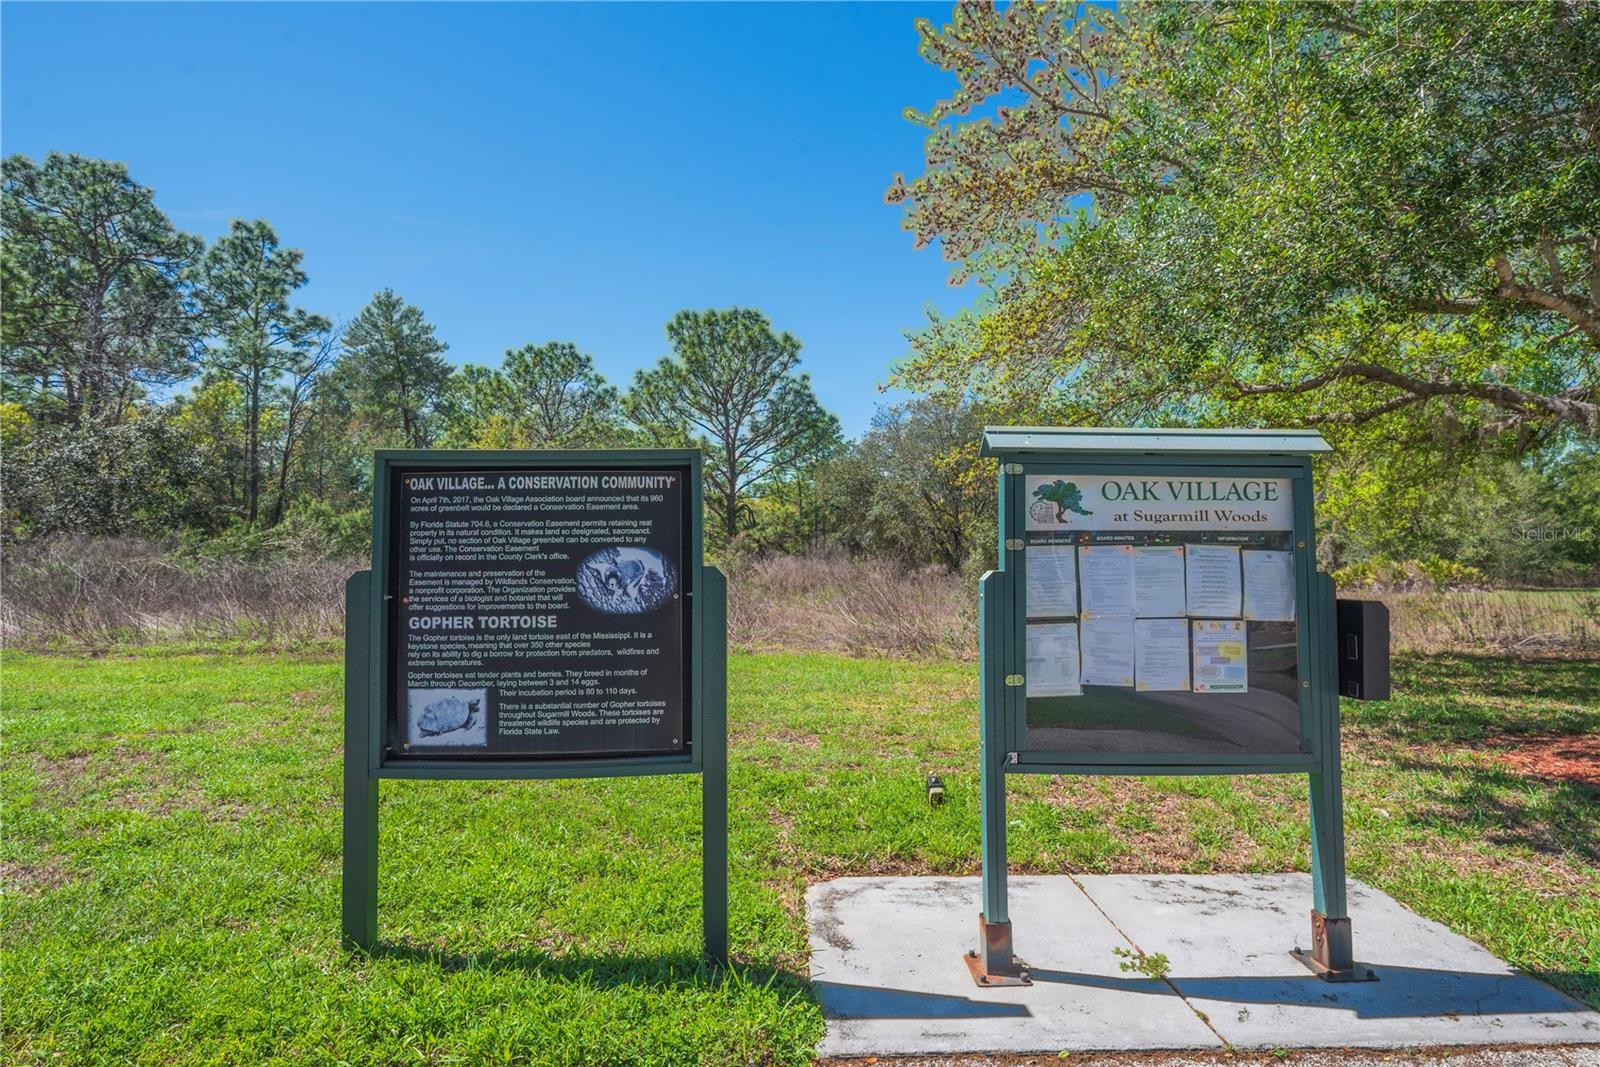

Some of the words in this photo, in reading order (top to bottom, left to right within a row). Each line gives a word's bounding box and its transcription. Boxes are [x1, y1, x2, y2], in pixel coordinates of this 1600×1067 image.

[410, 478, 433, 490] OAK
[438, 477, 494, 490] VILLAGE...
[497, 477, 505, 490] A
[509, 477, 598, 490] CONSERVATION
[602, 476, 672, 489] COMMUNITY
[1101, 480, 1160, 501] OAK
[1166, 481, 1279, 501] VILLAGE
[422, 496, 437, 505] April
[501, 496, 524, 504] Village
[438, 504, 470, 513] greenbelt
[1114, 512, 1129, 522] at
[1133, 510, 1209, 524] Sugarmill
[1215, 510, 1268, 522] Woods
[410, 521, 419, 529] By
[581, 520, 607, 528] permits
[608, 519, 638, 528] retaining
[410, 529, 437, 537] property
[415, 586, 444, 595] nonprofit
[502, 586, 545, 594] Organization
[546, 586, 576, 594] provides
[425, 603, 465, 612] suggestions
[477, 602, 525, 611] improvements
[408, 617, 473, 629] GOPHER
[478, 616, 558, 628] TORTOISE
[423, 634, 448, 642] Gopher
[496, 633, 511, 642] only
[408, 651, 420, 659] rely
[442, 650, 461, 658] ability
[471, 650, 482, 658] dig
[526, 649, 560, 658] protection
[408, 671, 433, 680] Gopher
[501, 670, 521, 678] plants
[566, 669, 582, 678] They
[430, 680, 456, 688] through
[496, 679, 517, 687] laying
[555, 688, 577, 697] period
[498, 710, 536, 719] throughout
[537, 710, 570, 718] Sugarmill
